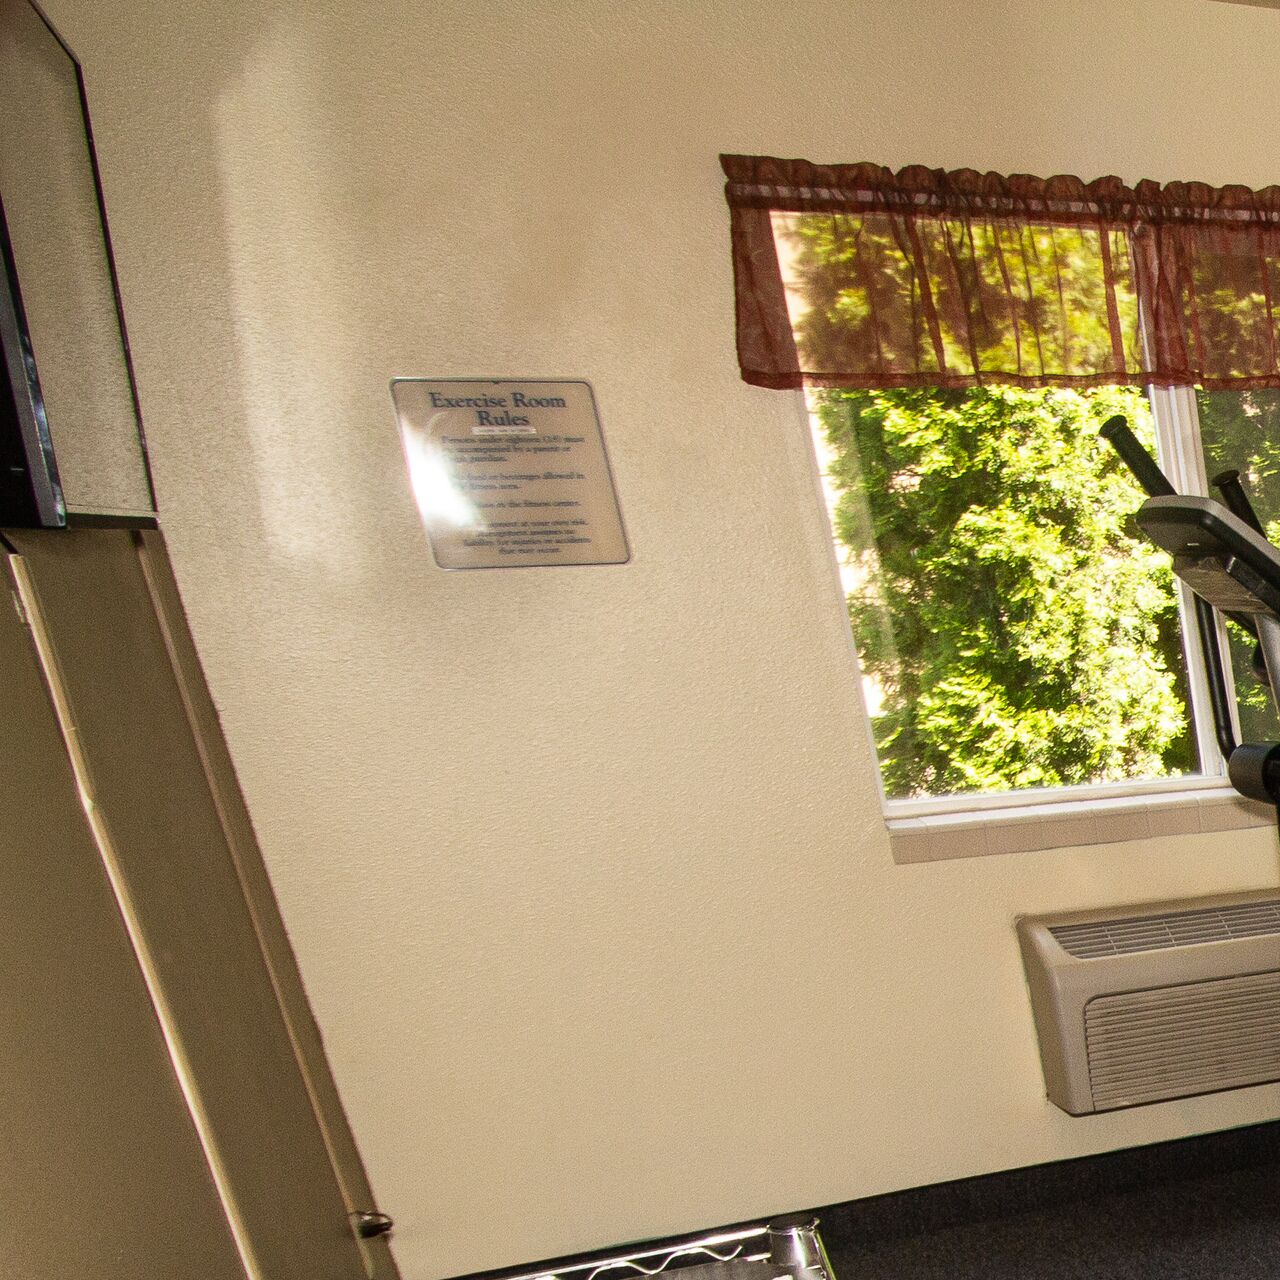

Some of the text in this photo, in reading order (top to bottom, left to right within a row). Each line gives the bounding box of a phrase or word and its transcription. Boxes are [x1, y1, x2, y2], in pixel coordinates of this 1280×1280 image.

[428, 391, 567, 409] Exercise Room
[476, 410, 530, 427] Rules
